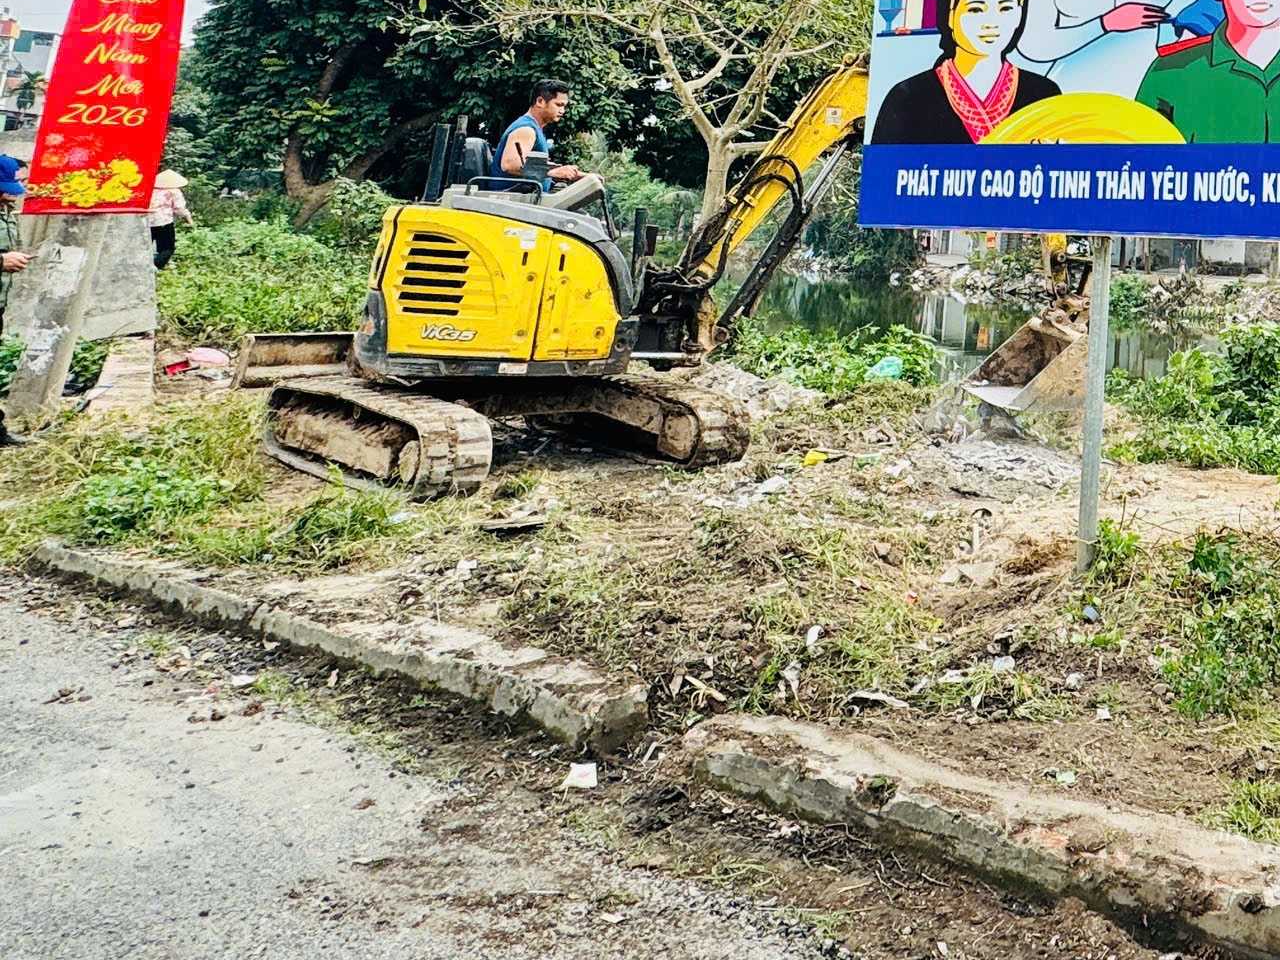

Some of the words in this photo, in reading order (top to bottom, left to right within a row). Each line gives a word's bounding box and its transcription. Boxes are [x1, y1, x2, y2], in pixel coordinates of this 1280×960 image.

[57, 103, 148, 126] 2026
[896, 164, 939, 197] PHÁT
[942, 169, 977, 198] HUY
[980, 169, 1014, 198] CAO
[1019, 164, 1044, 205] ĐỘ
[1050, 170, 1091, 199] TINH
[1151, 165, 1187, 201] YÊU
[1193, 165, 1256, 207] NƯỚC,
